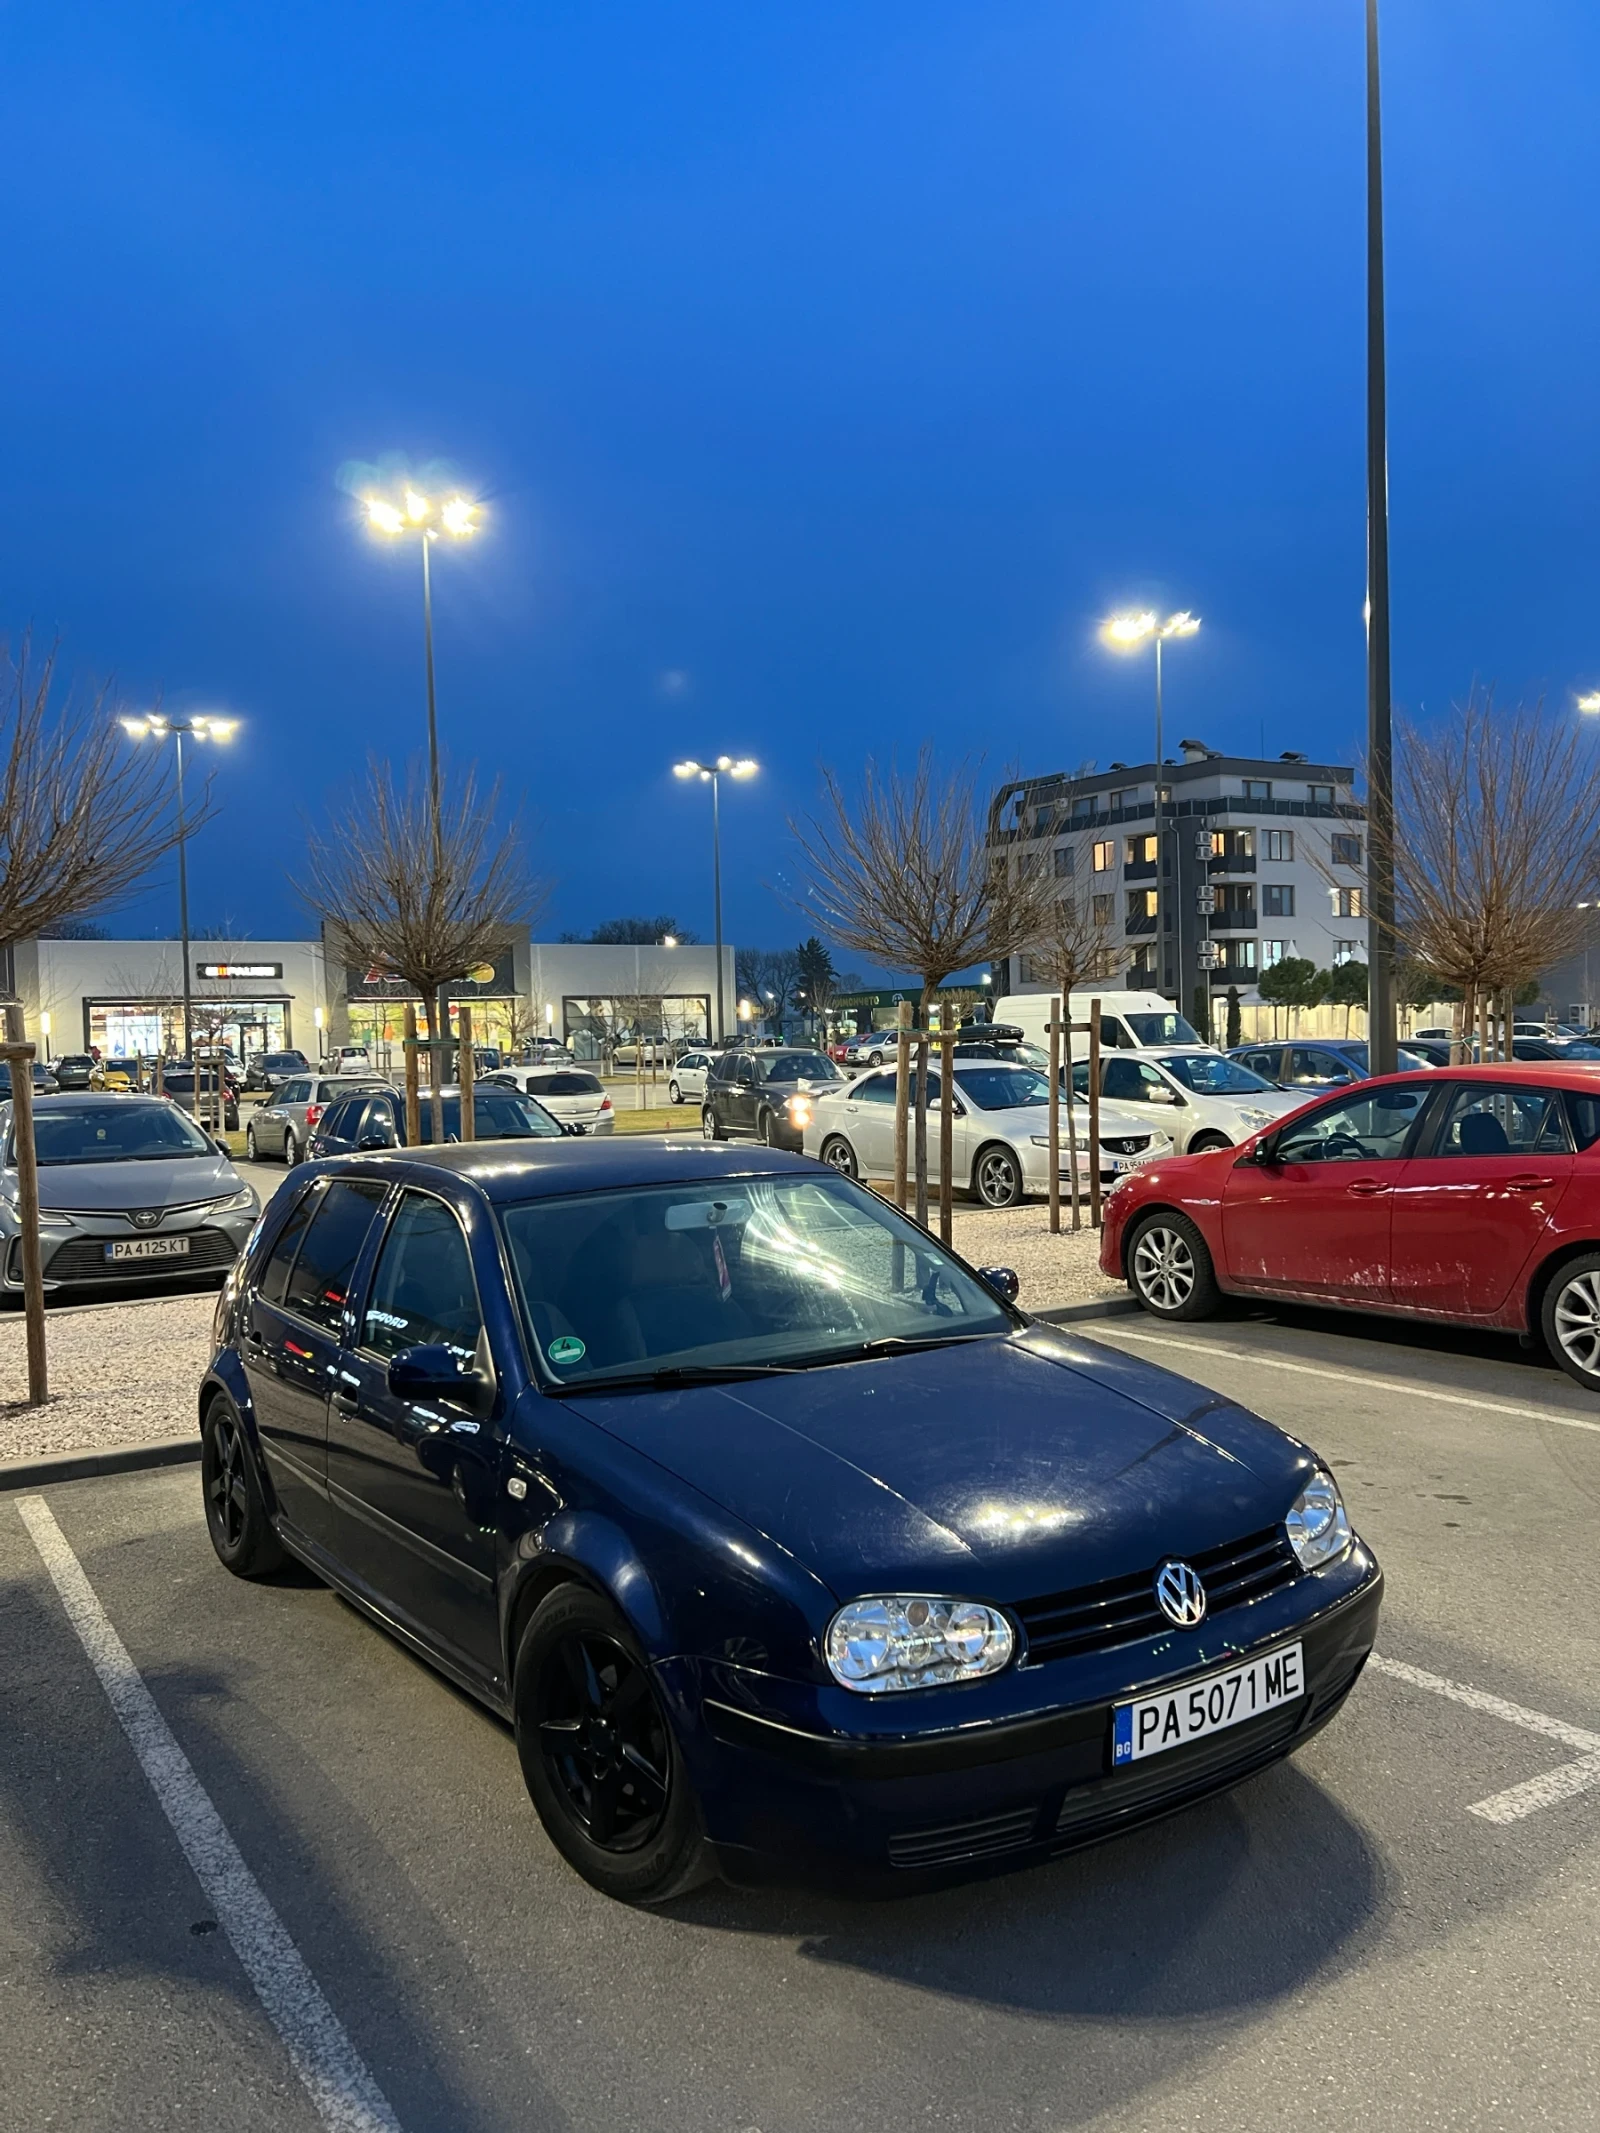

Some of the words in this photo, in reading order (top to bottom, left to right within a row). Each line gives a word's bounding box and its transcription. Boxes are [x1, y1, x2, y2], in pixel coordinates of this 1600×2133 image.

[115, 1244, 133, 1257] PA
[135, 1241, 167, 1254] 4125
[169, 1239, 187, 1252] KT
[1138, 1699, 1181, 1751] PA
[1188, 1668, 1256, 1732] 5071
[1265, 1651, 1299, 1703] ME
[1116, 1741, 1131, 1757] BG
